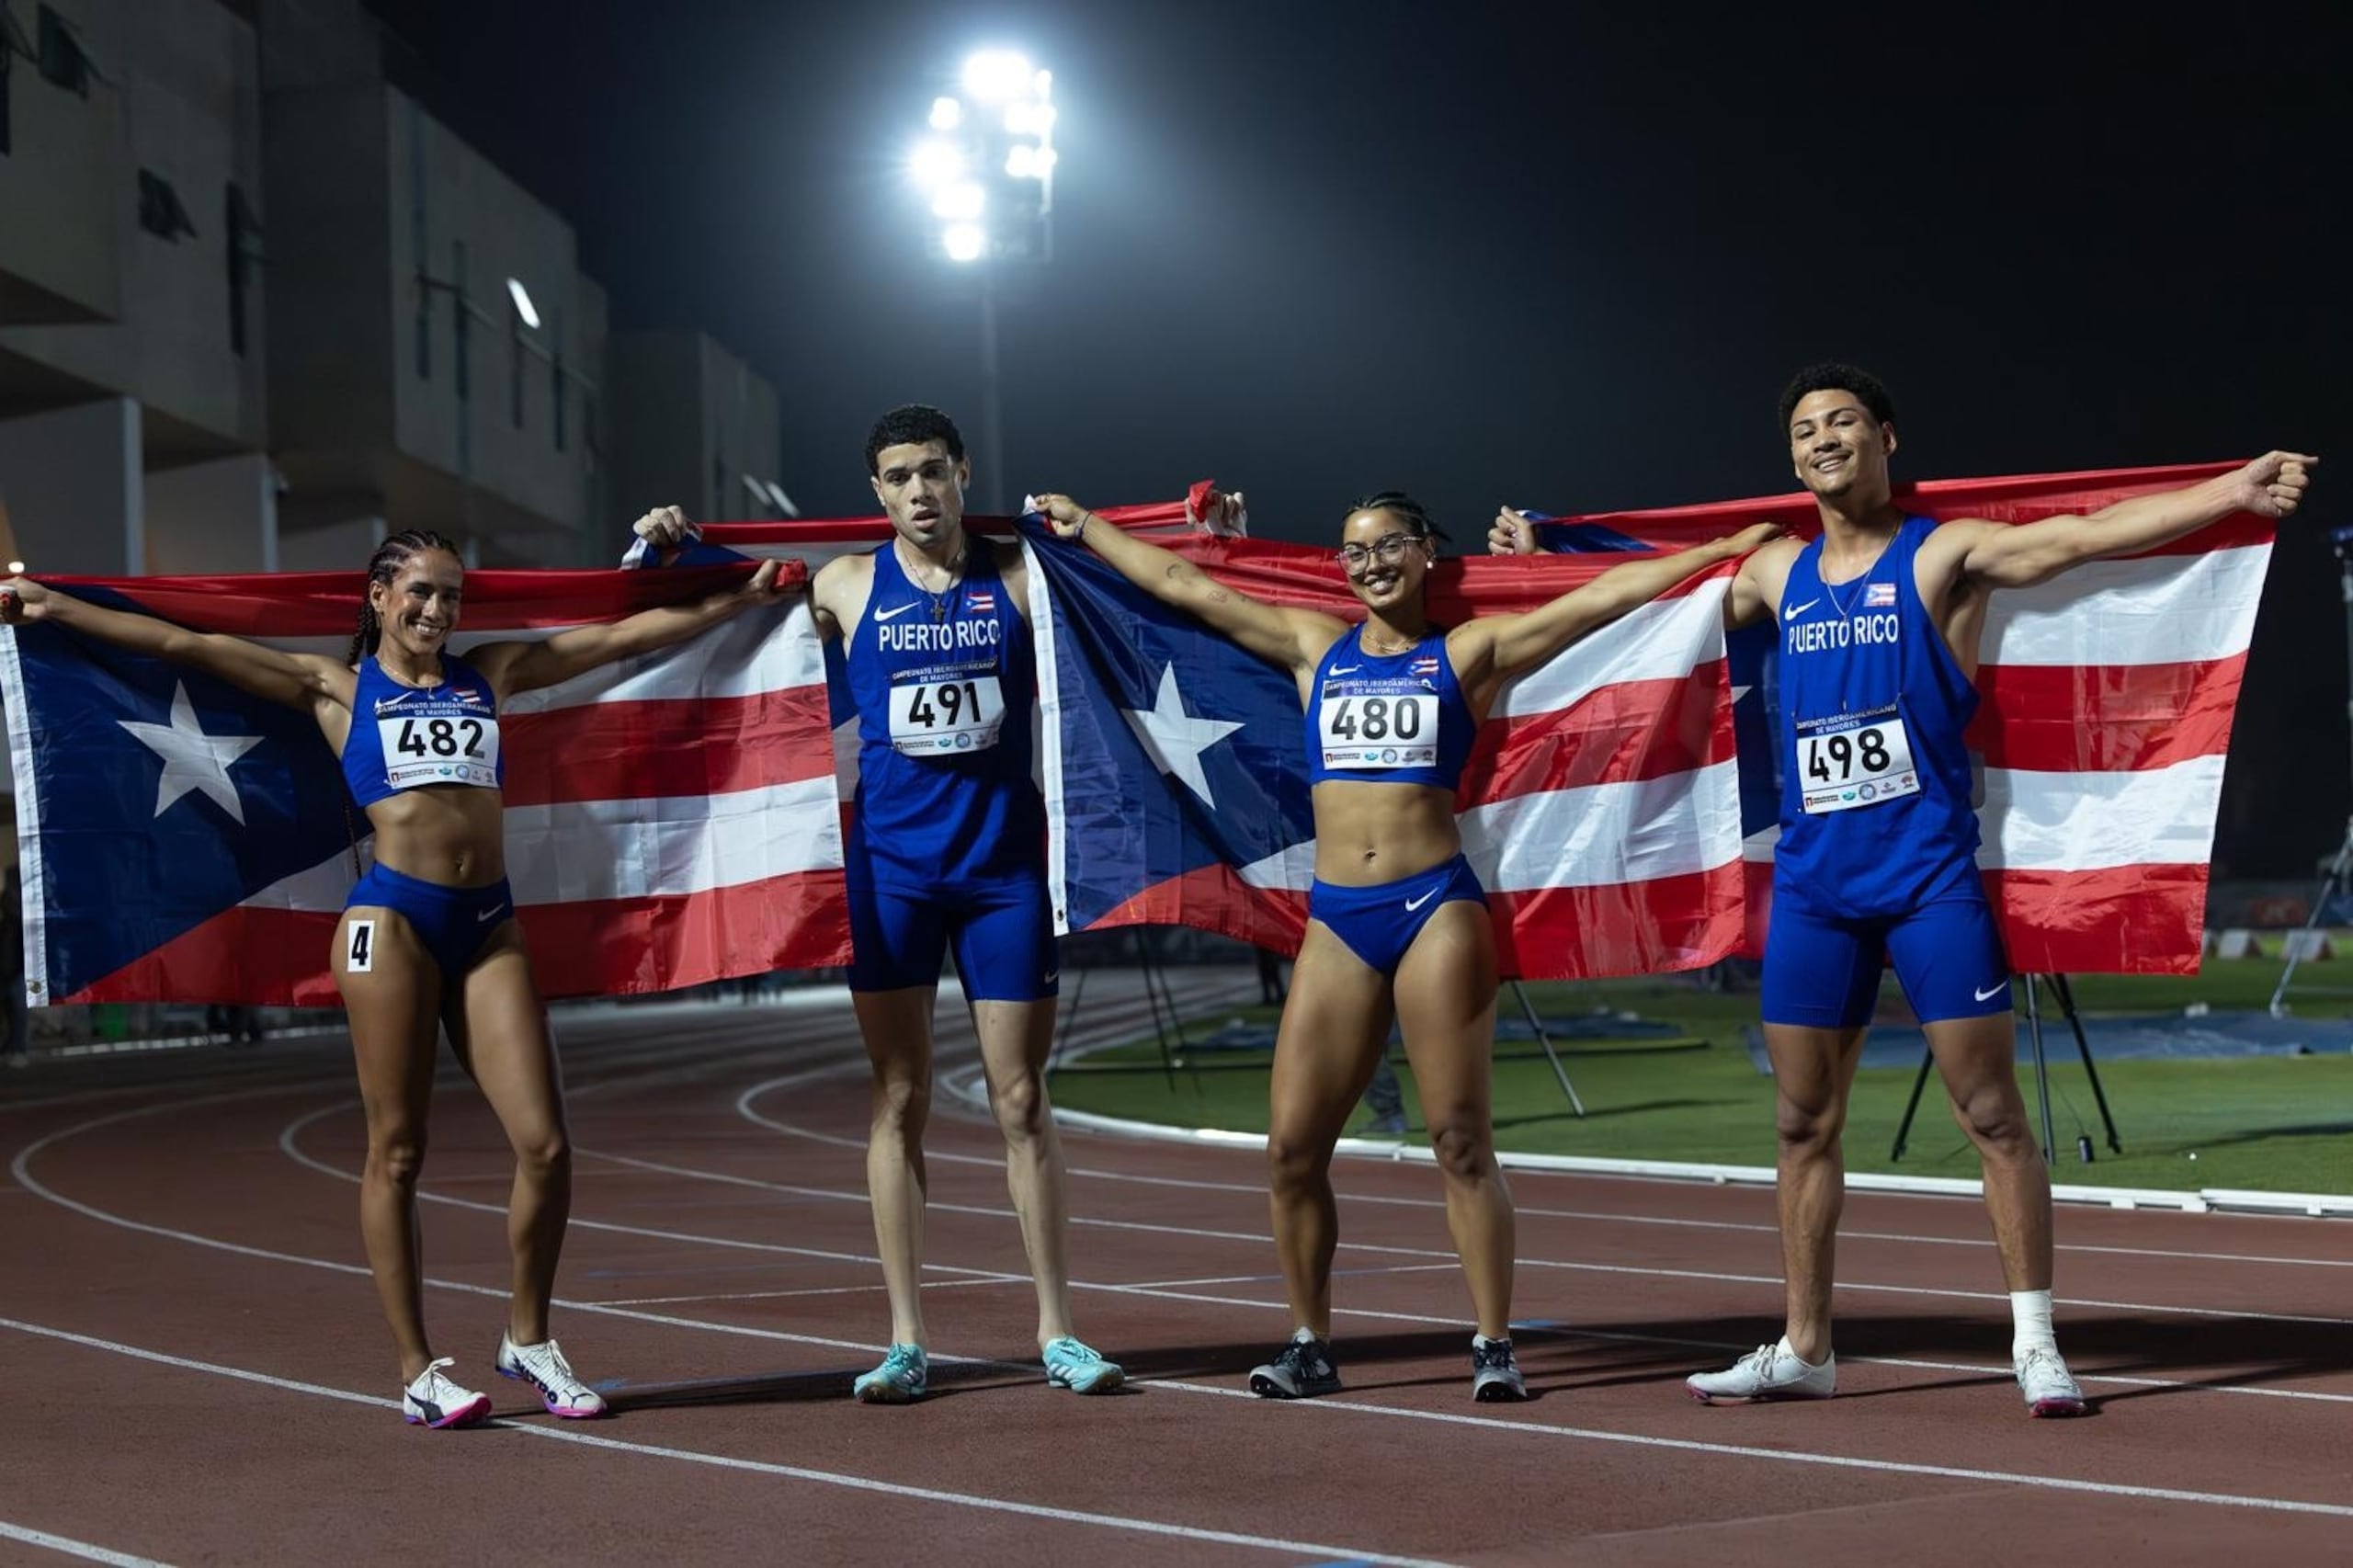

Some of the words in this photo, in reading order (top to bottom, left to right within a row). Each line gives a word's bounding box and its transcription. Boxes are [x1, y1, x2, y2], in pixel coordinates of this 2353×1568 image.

[879, 623, 953, 652] PUERTO
[955, 618, 1000, 648] RICO
[1788, 619, 1850, 655] PUERTO
[1853, 613, 1899, 645] RICO
[908, 681, 982, 728] 491
[1331, 698, 1420, 740] 480
[397, 719, 485, 759] 482
[1808, 728, 1891, 782] 498
[351, 926, 369, 966] 4
